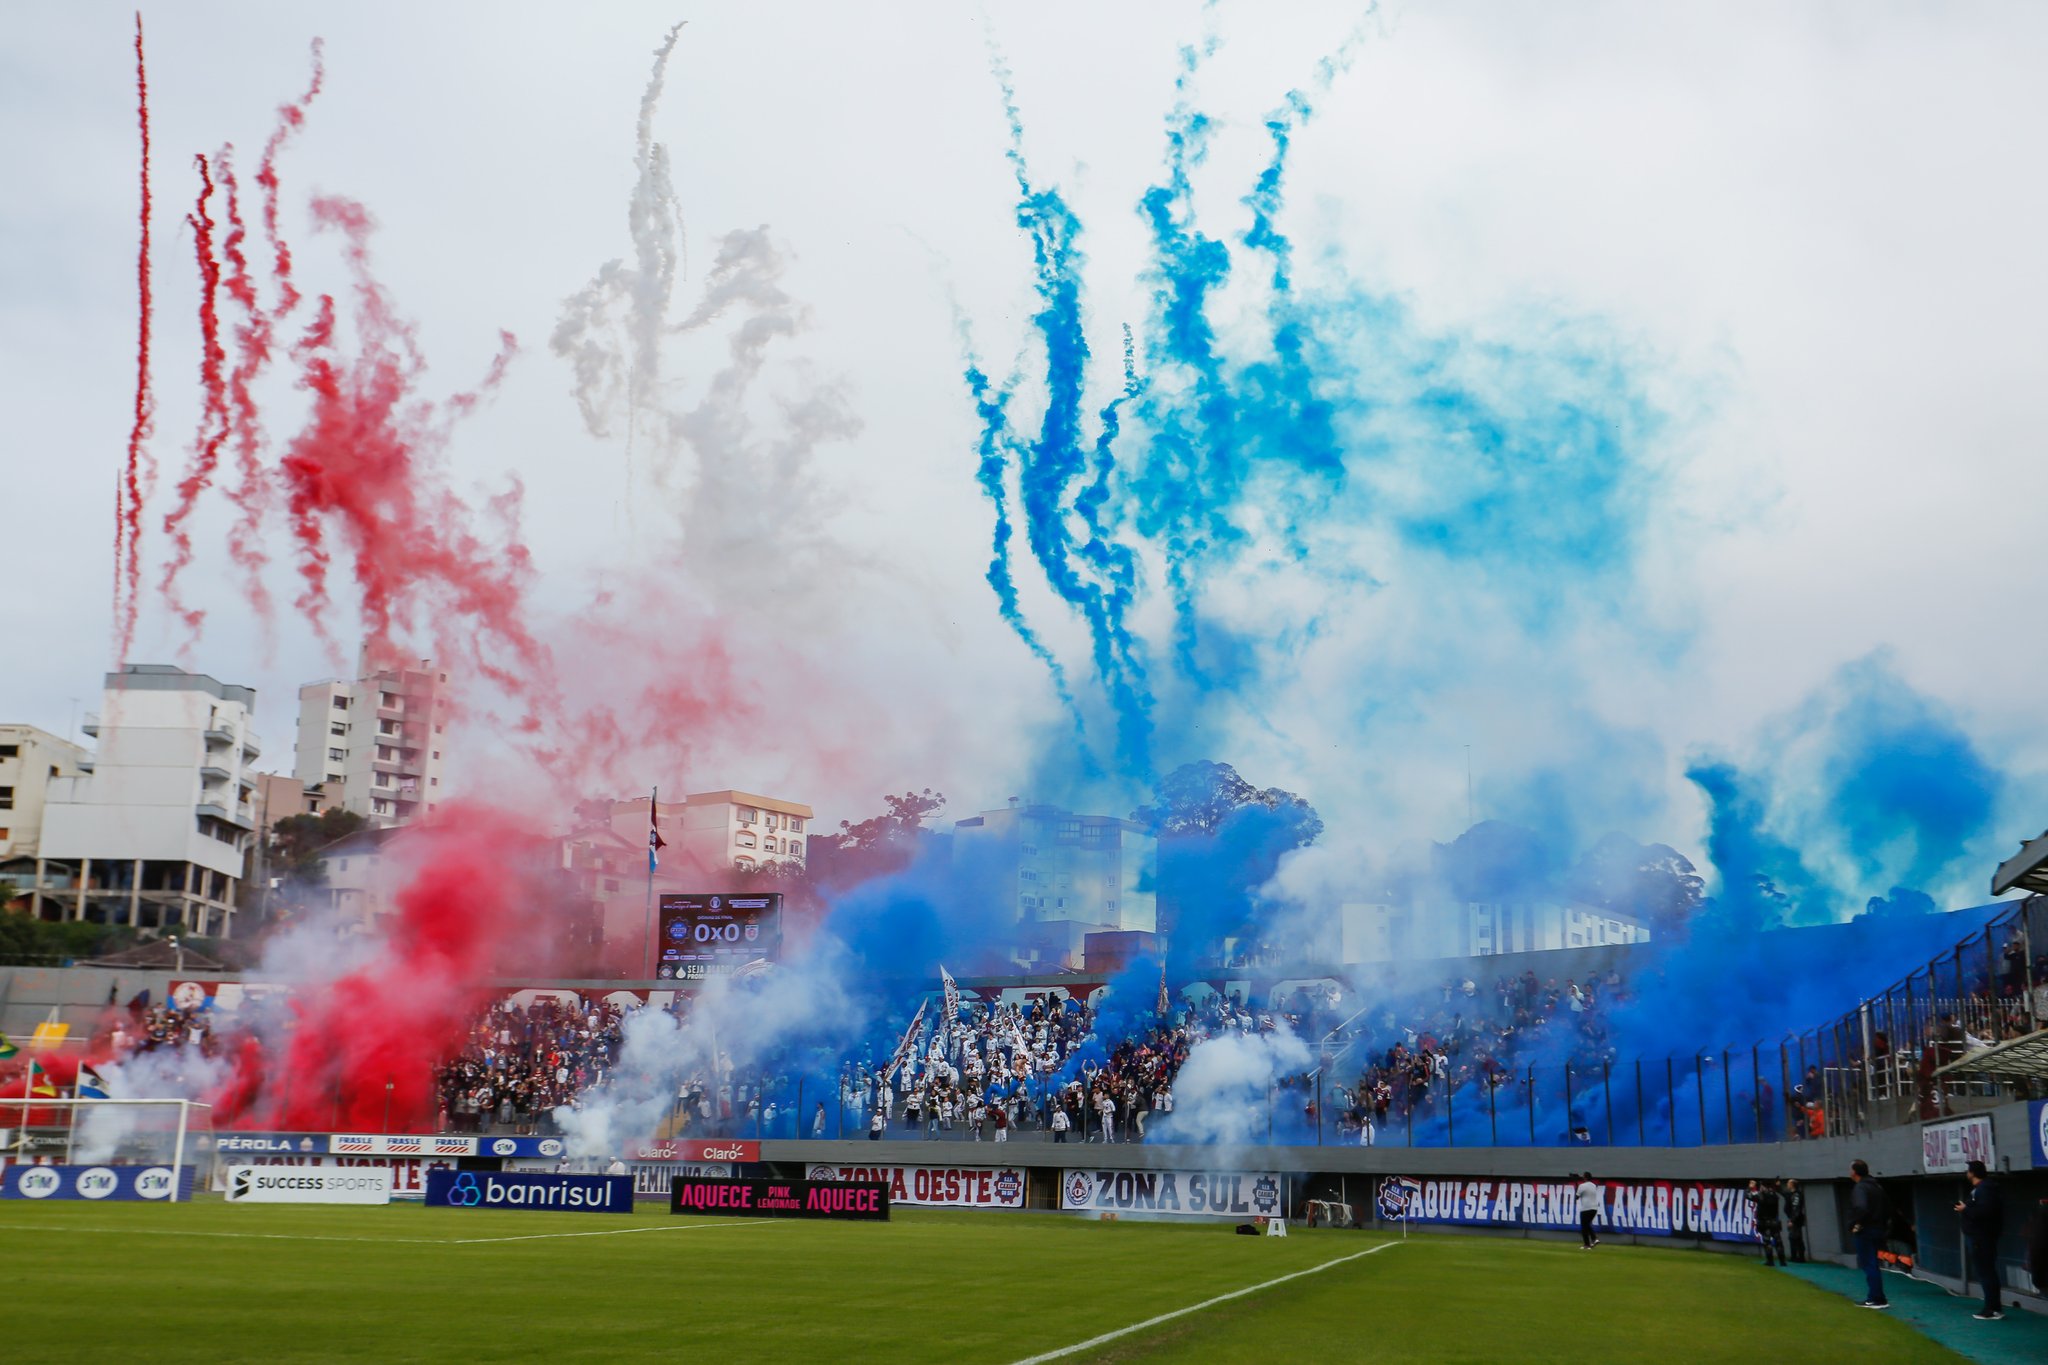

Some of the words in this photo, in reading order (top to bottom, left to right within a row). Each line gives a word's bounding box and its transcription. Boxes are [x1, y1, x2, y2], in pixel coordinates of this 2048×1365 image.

[686, 965, 704, 974] SEJA
[216, 1136, 293, 1151] PÉROLA
[638, 1145, 672, 1158] Claro
[703, 1146, 738, 1160] Claro
[257, 1176, 323, 1190] SUCCESS
[327, 1177, 383, 1191] SPORTS
[914, 1169, 993, 1203] OESTE
[485, 1177, 612, 1207] banrisul
[680, 1183, 753, 1210] AQUECE
[768, 1186, 791, 1198] PINK
[1095, 1171, 1181, 1211] ZONA
[1189, 1173, 1249, 1213] SUL
[757, 1198, 800, 1209] LEMONADE
[806, 1187, 880, 1213] AQUECE
[1409, 1181, 1461, 1219] AQUI
[1464, 1182, 1491, 1220] SE
[1492, 1182, 1580, 1225] APREND
[1612, 1186, 1669, 1230] AMAR
[1672, 1187, 1684, 1231] O
[1687, 1187, 1753, 1236] CAXIAS
